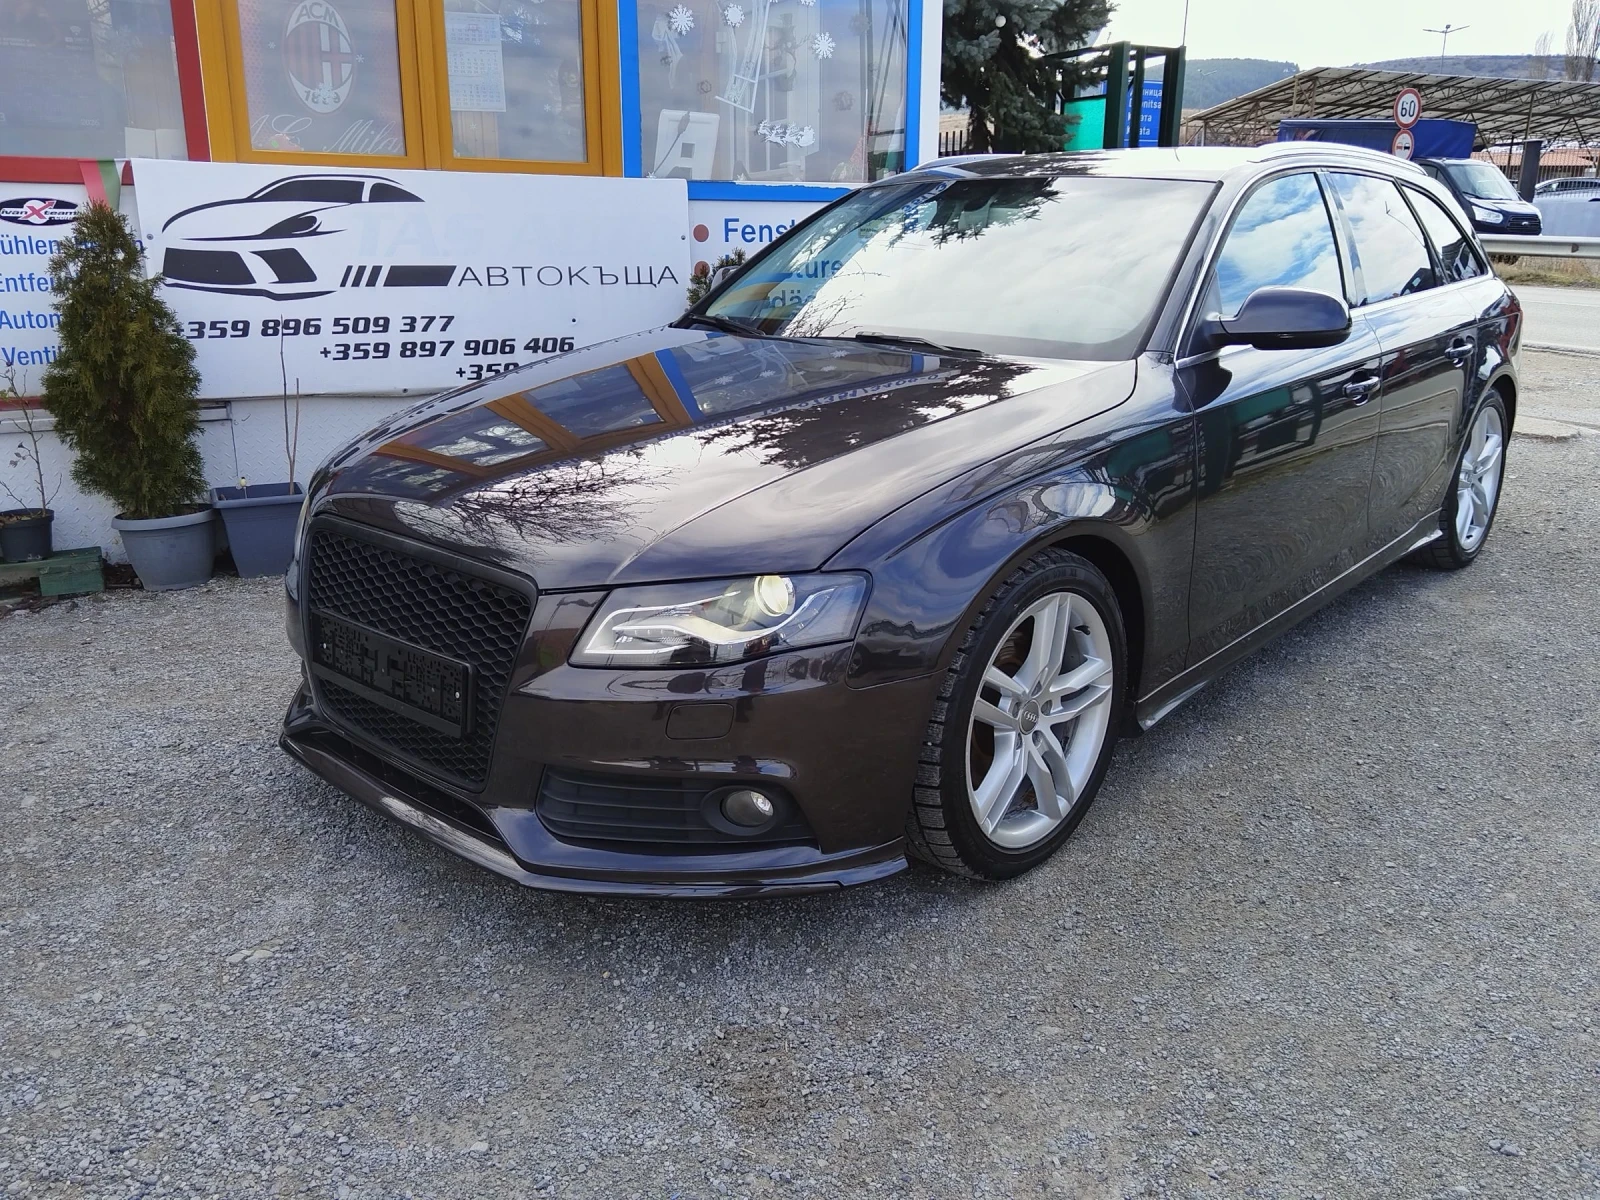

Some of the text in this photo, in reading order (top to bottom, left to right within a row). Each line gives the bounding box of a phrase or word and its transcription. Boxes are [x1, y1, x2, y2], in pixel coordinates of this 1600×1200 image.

[296, 2, 340, 27] ACM
[1400, 100, 1416, 117] 60
[0, 234, 62, 255] ühlen
[458, 266, 679, 288] АВТОКЪЩА
[172, 315, 455, 340] +359 896 509 377
[320, 336, 575, 361] +359 897 906 406
